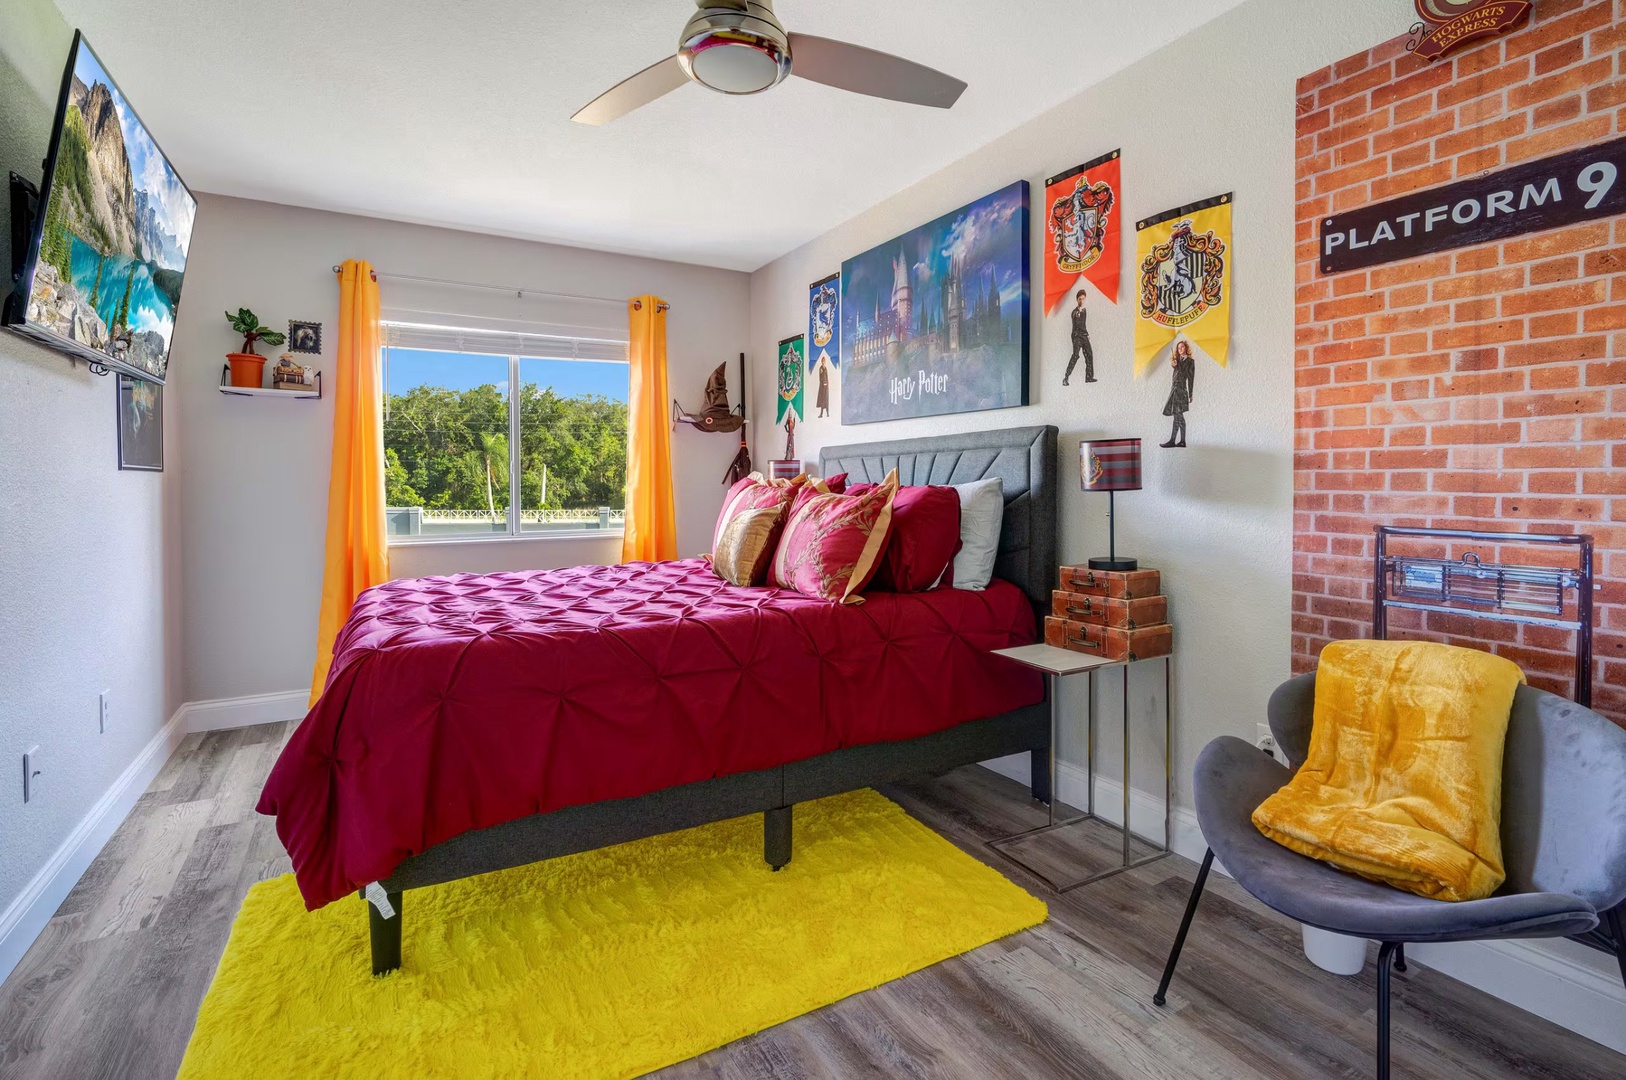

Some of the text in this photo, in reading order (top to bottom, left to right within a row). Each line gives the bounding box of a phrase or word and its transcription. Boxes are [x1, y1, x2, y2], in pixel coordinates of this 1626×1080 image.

[1431, 6, 1506, 43] HOGWARTS
[1439, 17, 1498, 47] EXPRESS
[1325, 161, 1618, 256] PLATFORM 9
[888, 369, 949, 405] Harry Potter
